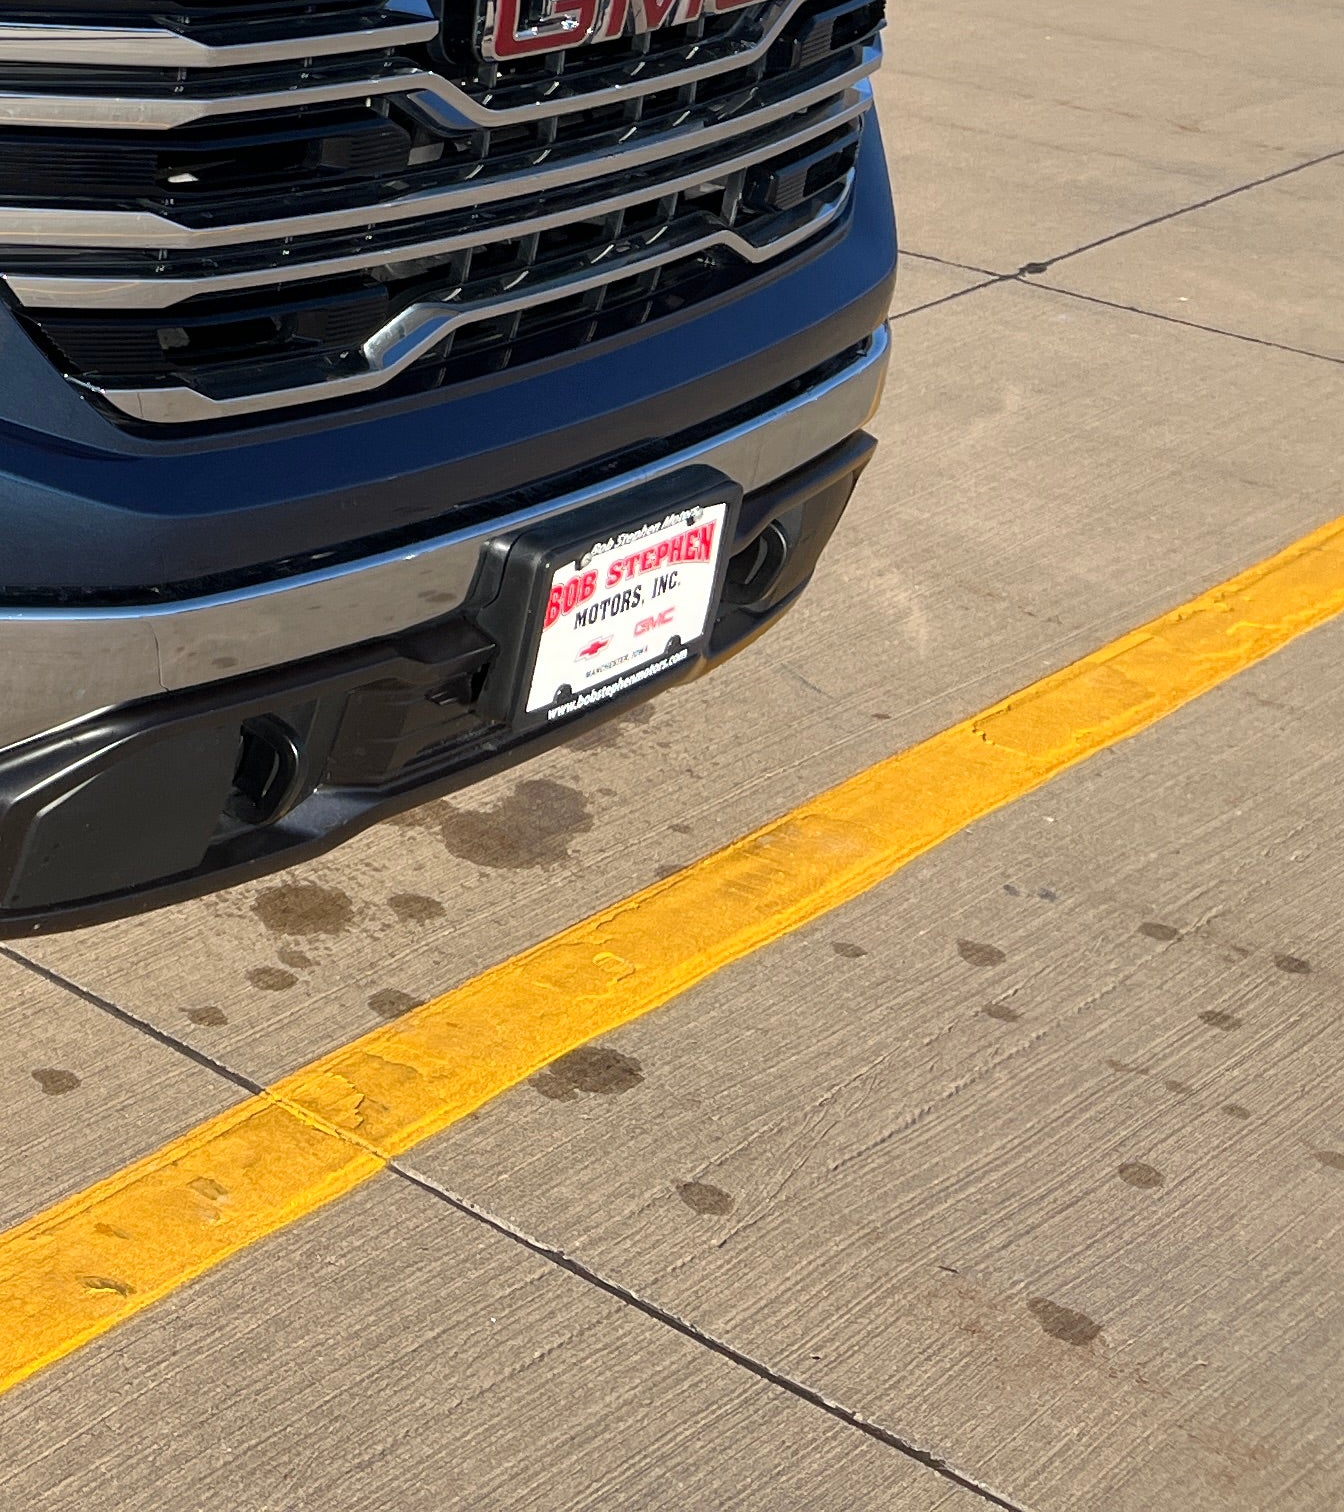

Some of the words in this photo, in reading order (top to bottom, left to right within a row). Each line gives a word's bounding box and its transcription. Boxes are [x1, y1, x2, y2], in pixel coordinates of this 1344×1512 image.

[543, 569, 598, 633] BOB
[605, 519, 717, 589] STEPHEN
[651, 570, 681, 599] INC.
[633, 605, 675, 638] GMC
